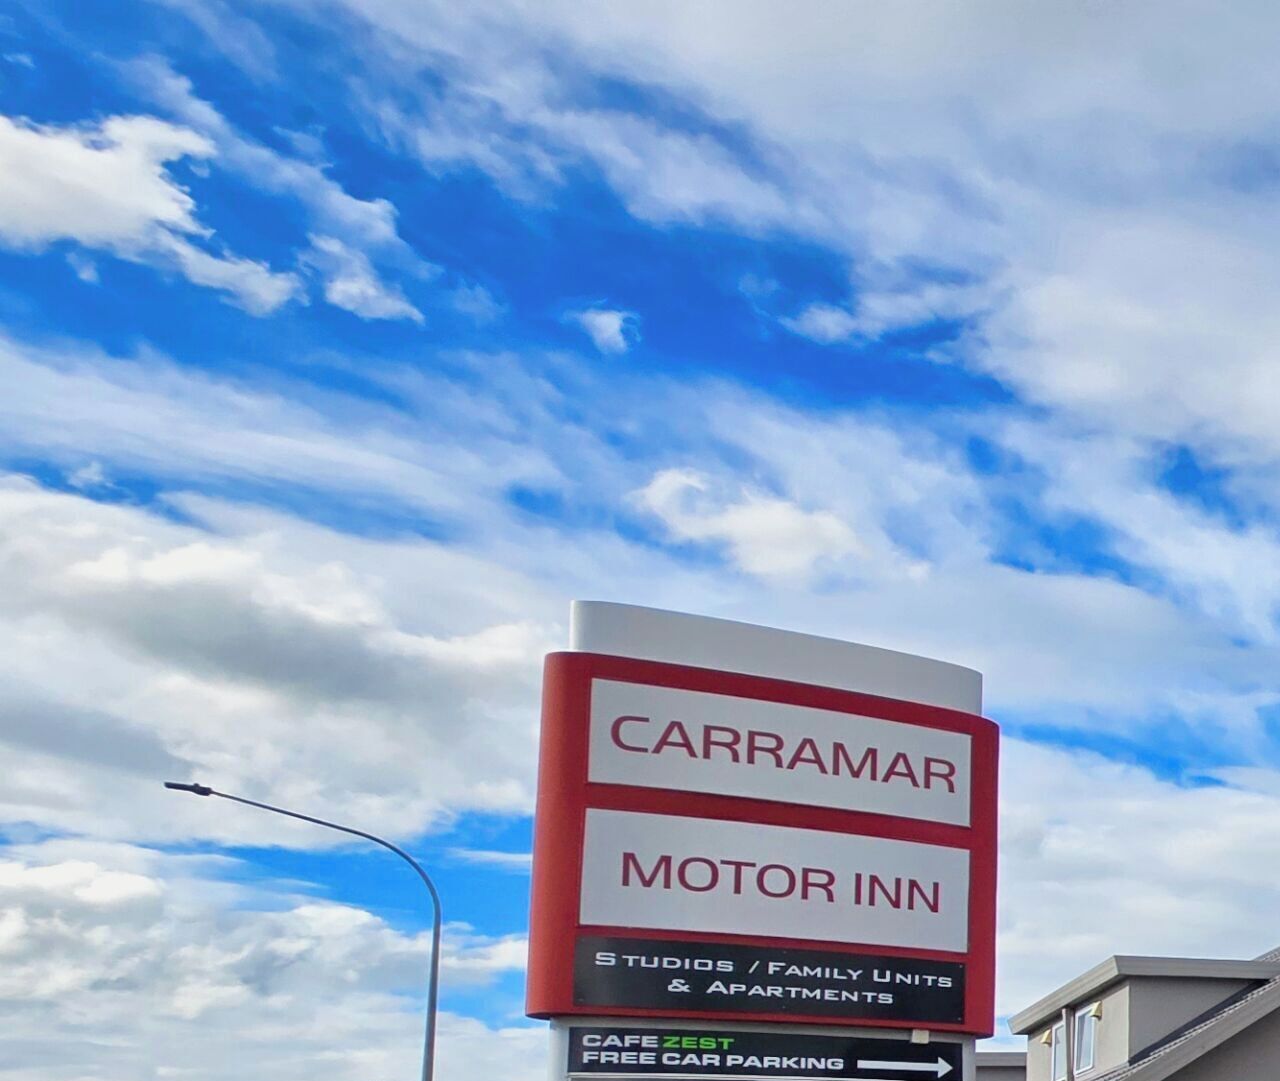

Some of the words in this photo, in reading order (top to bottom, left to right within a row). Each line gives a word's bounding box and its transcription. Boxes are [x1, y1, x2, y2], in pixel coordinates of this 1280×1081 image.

[610, 714, 957, 794] CARRAMAR
[620, 852, 835, 903] MOTOR
[853, 872, 940, 914] INN
[595, 952, 734, 972] STUDIOS
[768, 962, 863, 981] FAMILY
[873, 969, 953, 988] UNITS
[667, 978, 692, 993] &
[706, 980, 894, 1004] APARTMENTS
[582, 1034, 658, 1048] CAFE
[662, 1036, 735, 1050] ZEST
[582, 1051, 657, 1065] FREE
[661, 1052, 720, 1066] CAR
[726, 1054, 844, 1070] PARKING
